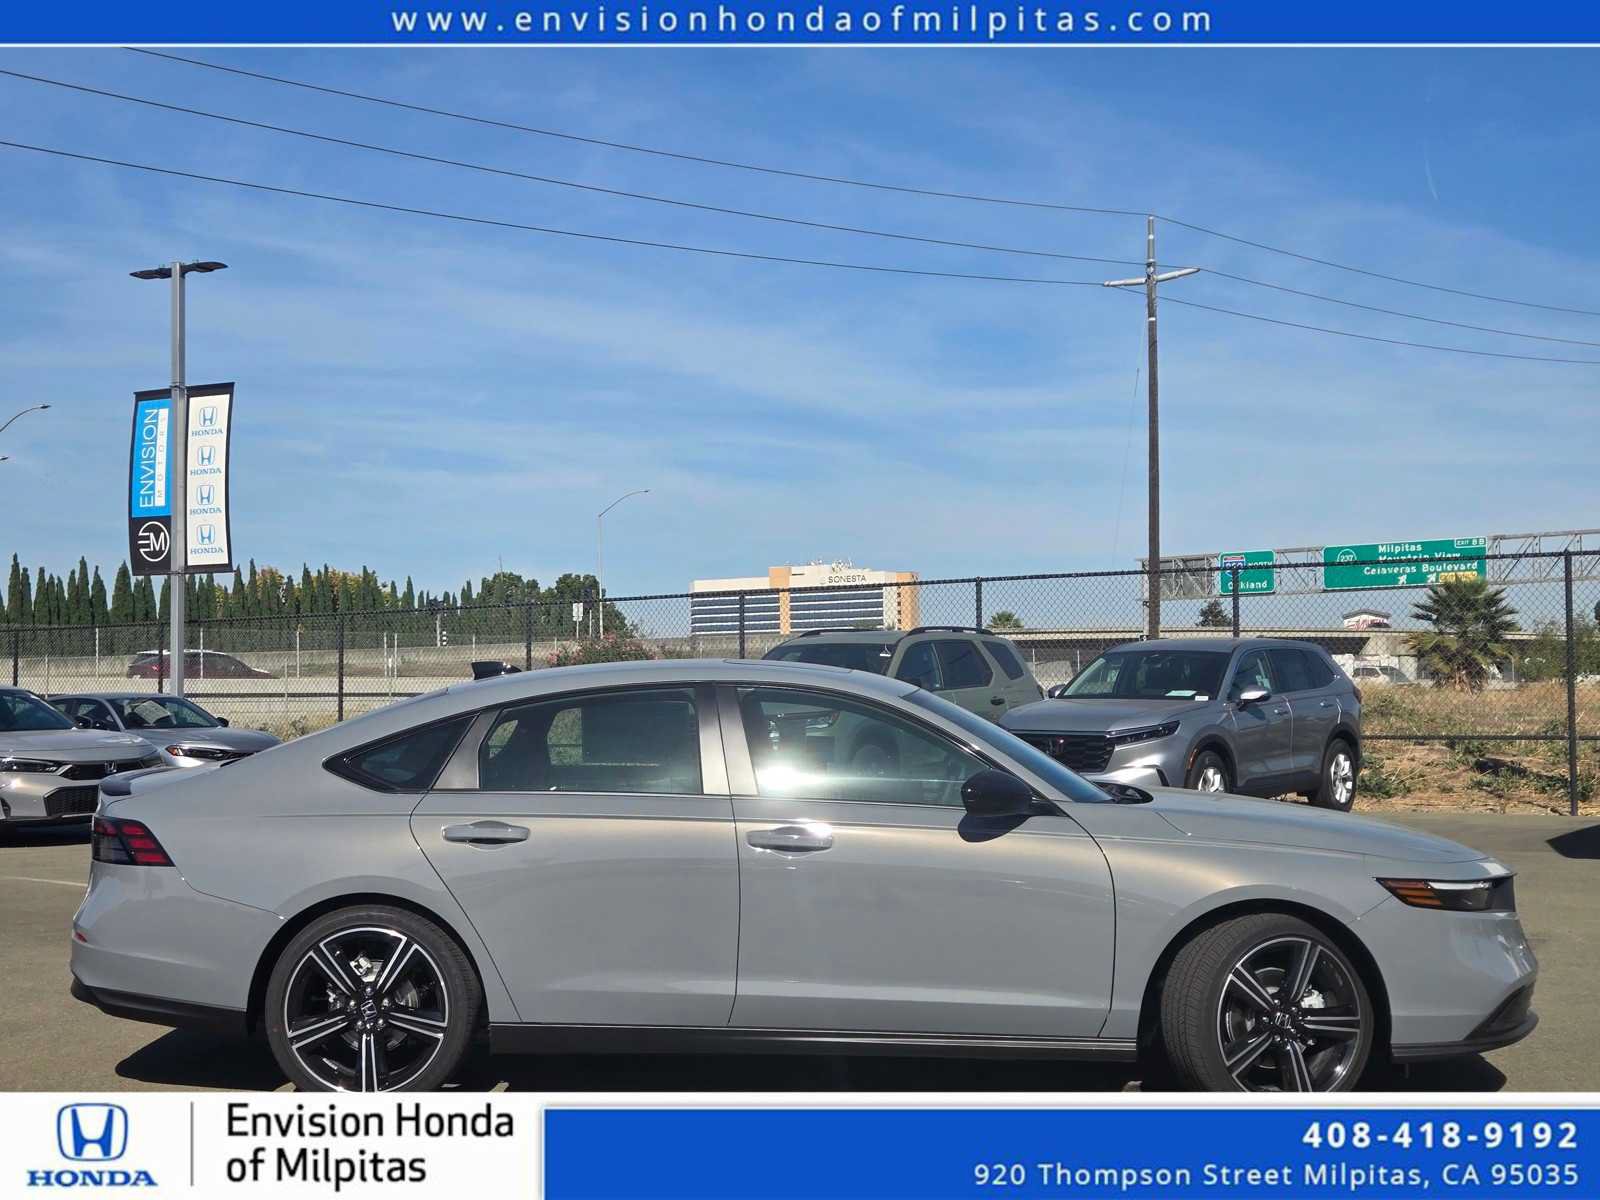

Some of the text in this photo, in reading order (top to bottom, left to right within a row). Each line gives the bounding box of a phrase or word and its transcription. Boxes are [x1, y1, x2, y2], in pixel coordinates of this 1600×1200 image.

[191, 428, 224, 437] HONDA
[139, 408, 158, 508] ENVISION
[190, 467, 222, 476] HONDA
[190, 507, 222, 515] HONDA
[190, 547, 224, 555] HONDA
[1378, 543, 1423, 554] Milpitas
[828, 574, 867, 584] SONESTA
[1227, 580, 1268, 590] Okland
